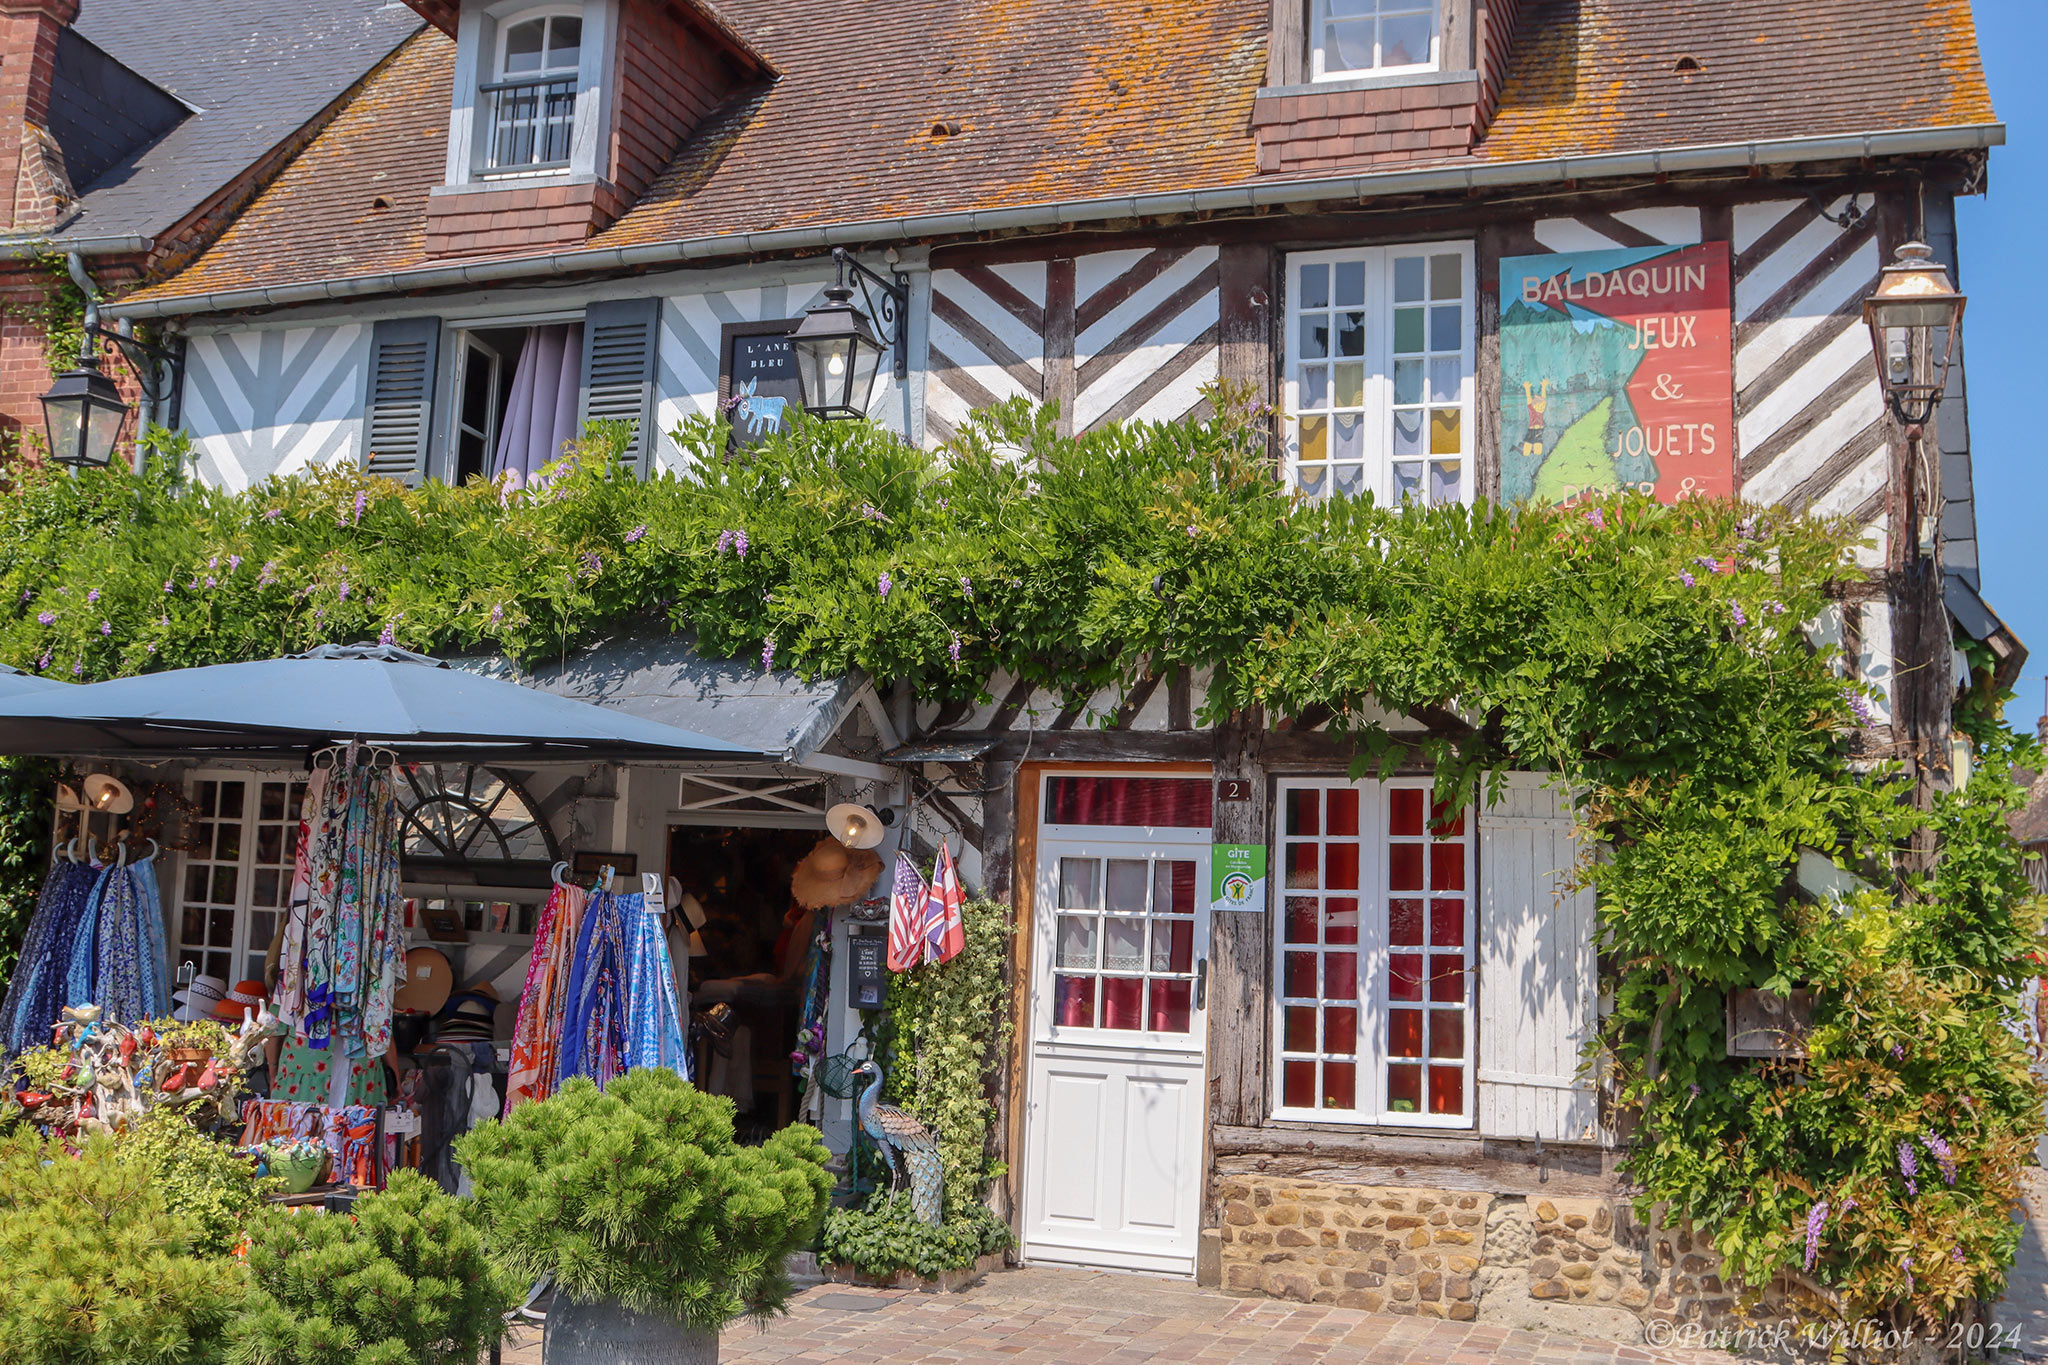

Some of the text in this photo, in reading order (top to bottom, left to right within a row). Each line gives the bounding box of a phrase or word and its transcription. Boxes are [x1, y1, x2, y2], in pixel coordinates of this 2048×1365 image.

[1522, 264, 1706, 302] BALDAQUIN
[1628, 316, 1697, 350] JEUX
[750, 359, 784, 368] BLEU
[1651, 373, 1684, 400] &
[1612, 423, 1716, 457] JOUETS
[1229, 782, 1239, 797] 2
